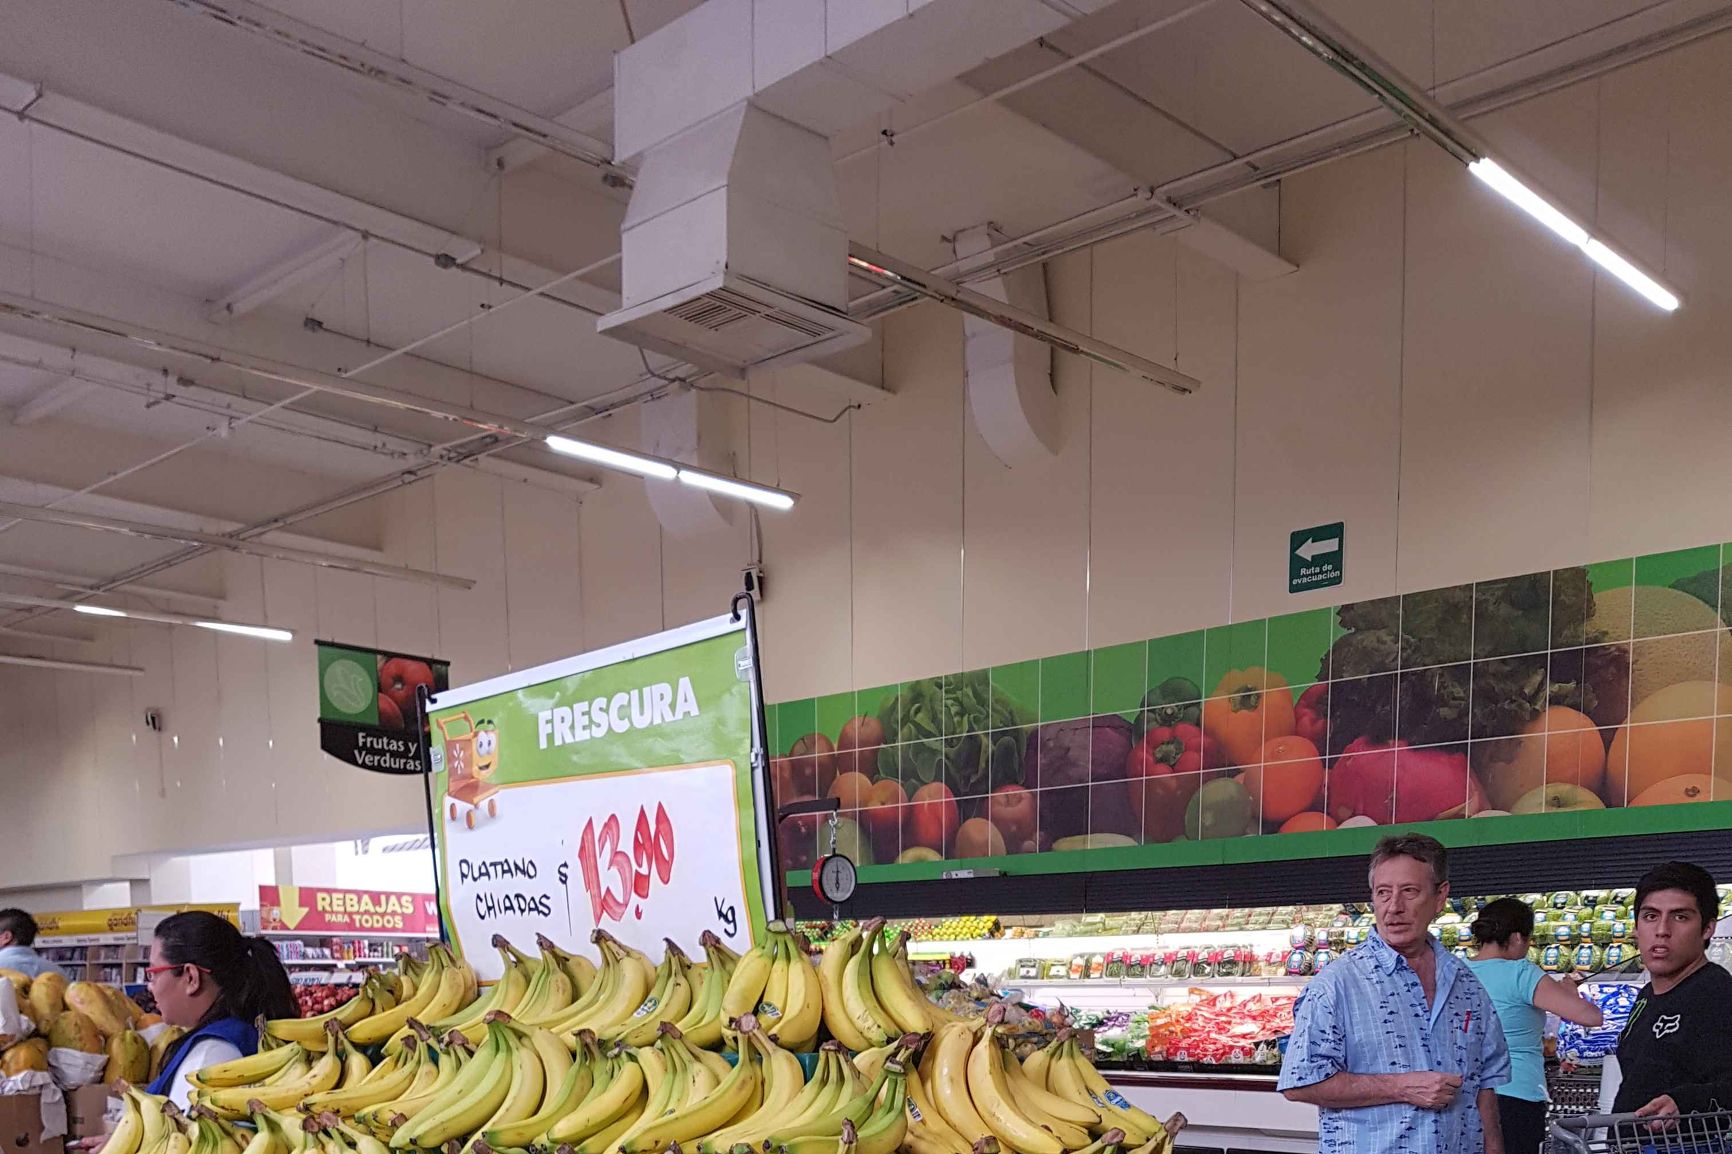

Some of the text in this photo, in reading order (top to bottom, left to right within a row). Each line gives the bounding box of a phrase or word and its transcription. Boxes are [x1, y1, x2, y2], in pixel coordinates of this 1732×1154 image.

[1292, 570, 1341, 585] evacuación
[1300, 567, 1320, 575] Ruta
[538, 676, 699, 750] FRESCURA
[357, 732, 418, 757] Frutas y
[354, 749, 422, 771] Verduras
[459, 857, 537, 885] PLATANO
[316, 892, 414, 914] REBAJAS
[325, 913, 403, 929] PARA TODOS
